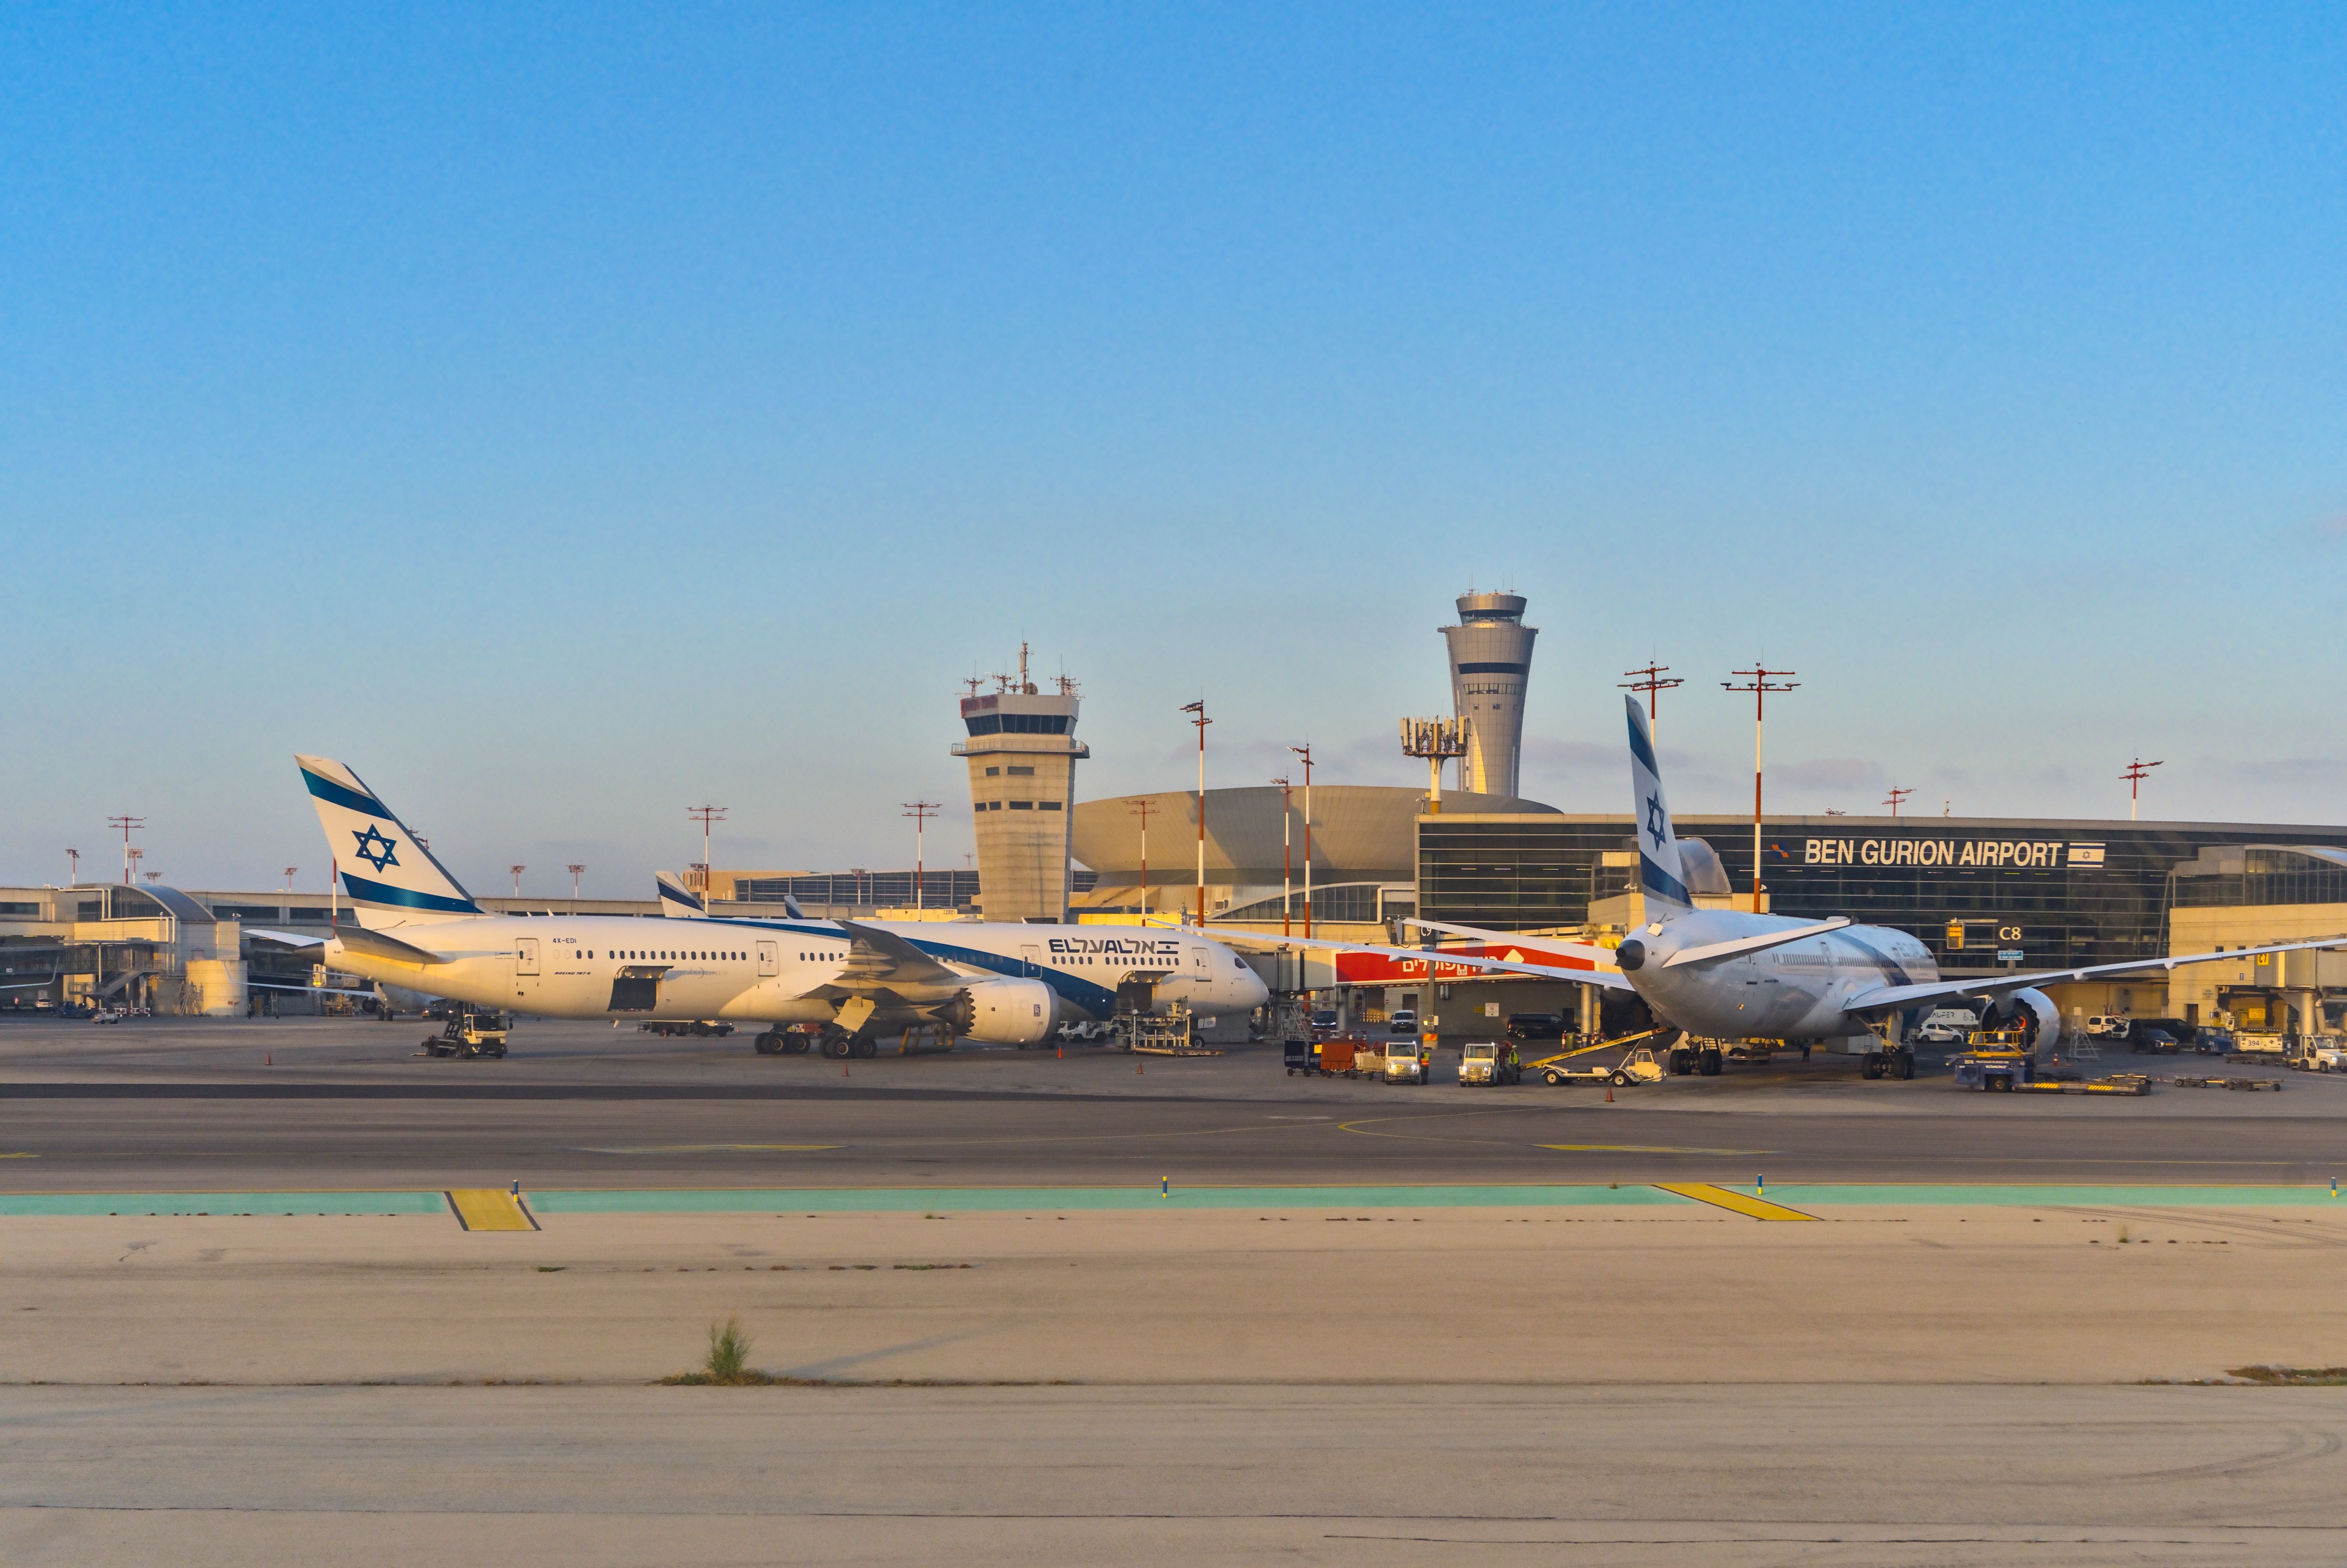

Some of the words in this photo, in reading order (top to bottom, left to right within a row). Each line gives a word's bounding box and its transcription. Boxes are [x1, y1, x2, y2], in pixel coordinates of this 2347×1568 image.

[1805, 839, 1854, 863] BEN
[1861, 840, 1954, 865] GURION
[1959, 841, 2063, 867] AIRPORT
[1421, 926, 1432, 936] C9
[1999, 927, 2021, 940] C8
[2259, 954, 2267, 963] C7
